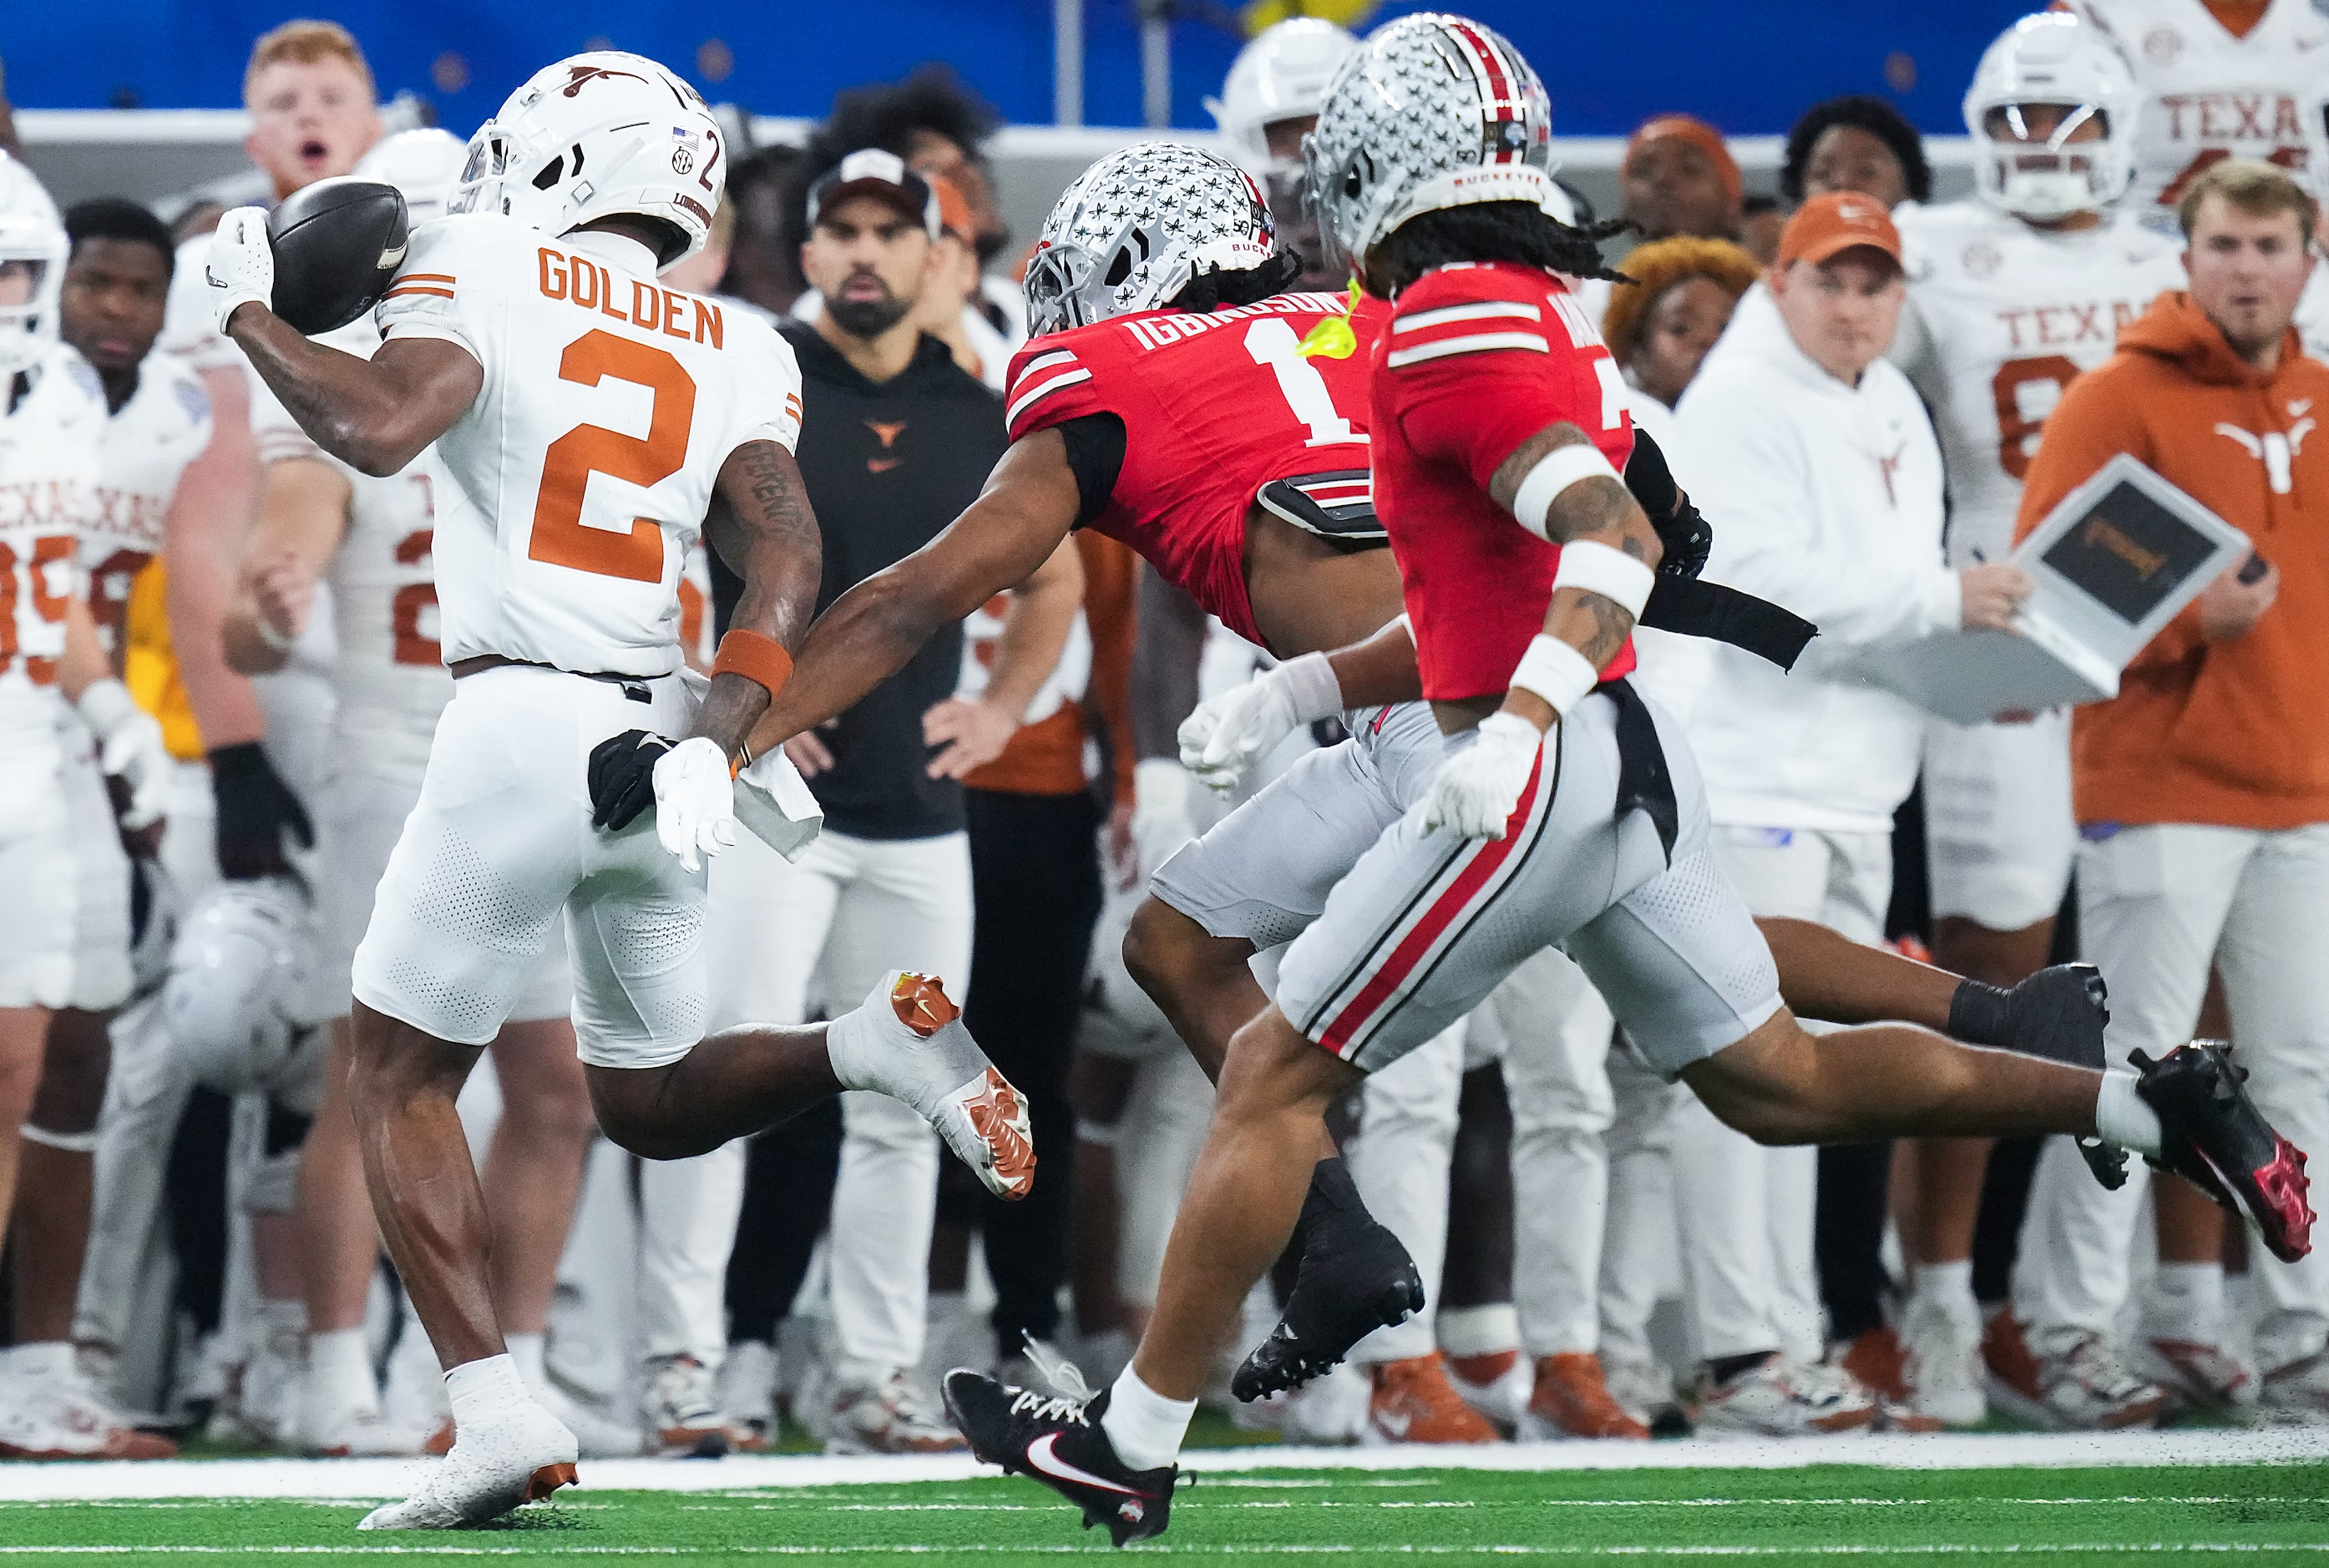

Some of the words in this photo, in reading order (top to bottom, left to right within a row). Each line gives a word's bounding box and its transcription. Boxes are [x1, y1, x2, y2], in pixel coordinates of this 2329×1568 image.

[2159, 93, 2302, 141] TEXA
[671, 149, 693, 175] SEC
[698, 129, 720, 192] 2
[537, 246, 723, 350] GOLDEN
[1997, 303, 2151, 347] TEXA
[1243, 317, 1370, 448] 1
[529, 328, 697, 584] 2
